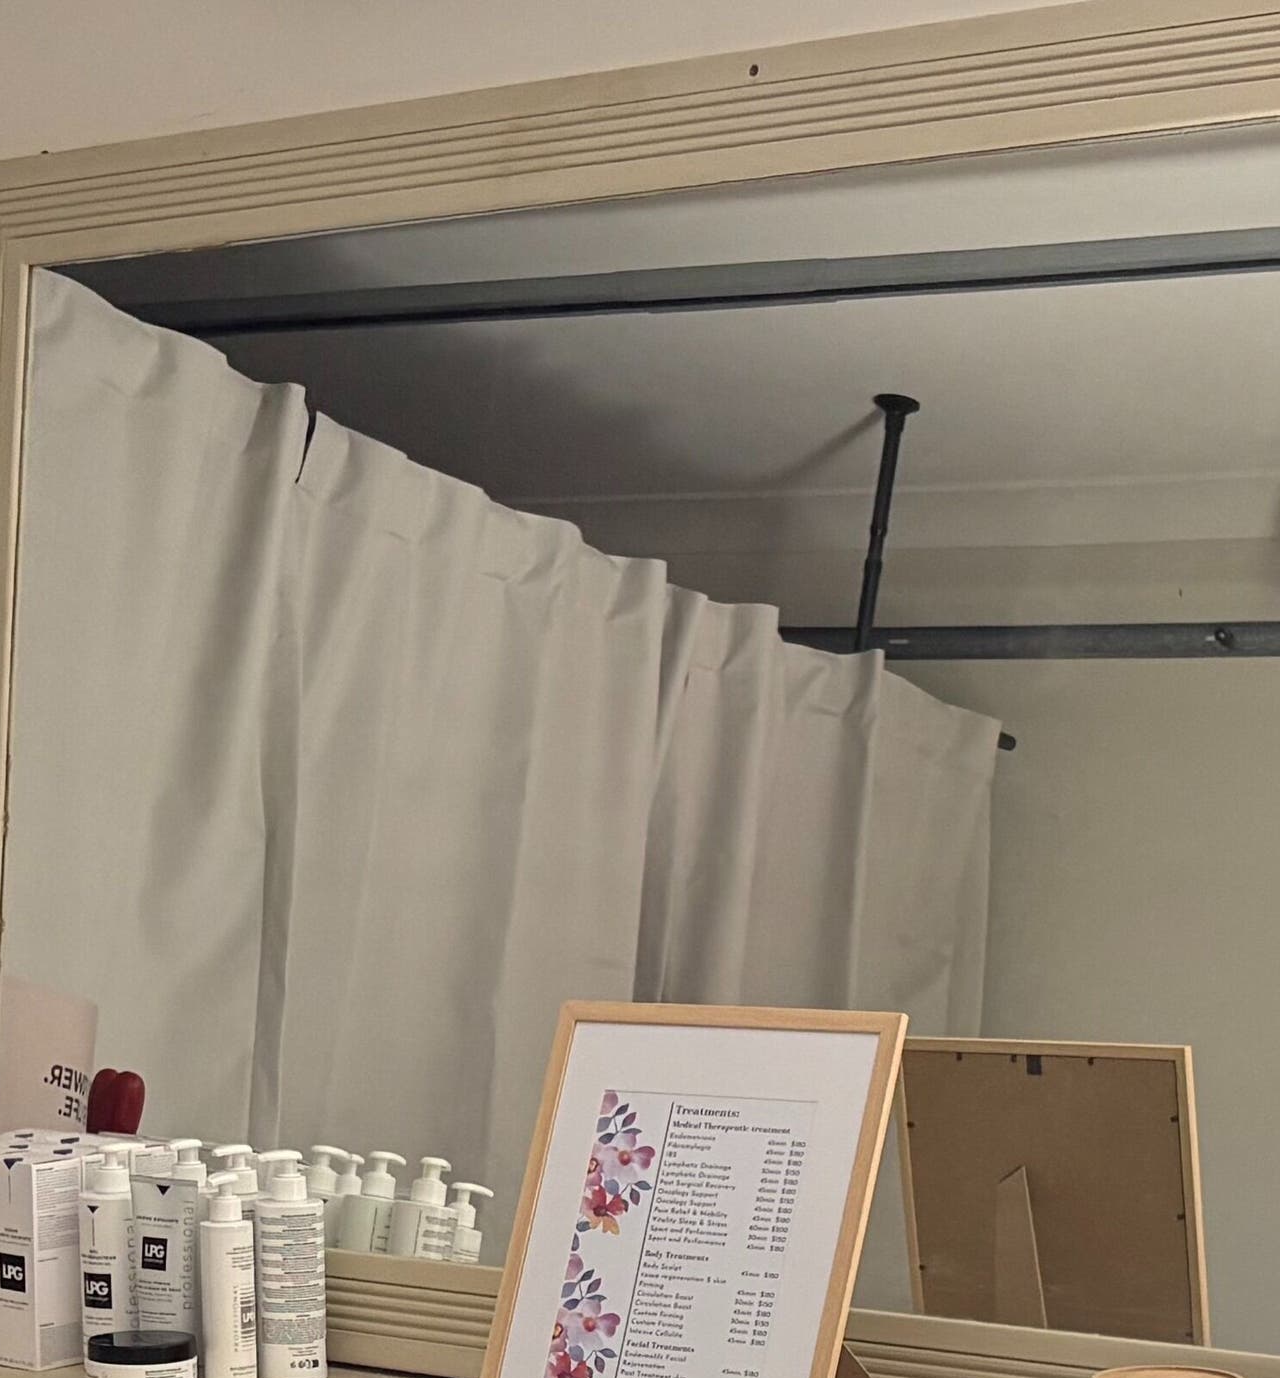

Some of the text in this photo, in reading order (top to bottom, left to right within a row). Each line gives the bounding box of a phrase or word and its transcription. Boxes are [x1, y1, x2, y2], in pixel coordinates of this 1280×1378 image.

[676, 1105, 740, 1118] Treatments:
[672, 1121, 701, 1130] Medical
[692, 1191, 718, 1199] Support
[144, 1243, 165, 1259] LPG
[666, 1252, 709, 1261] Treatments
[2, 1263, 23, 1280] LPG
[86, 1280, 109, 1296] LPG
[626, 1340, 695, 1353] Facial Treatments
